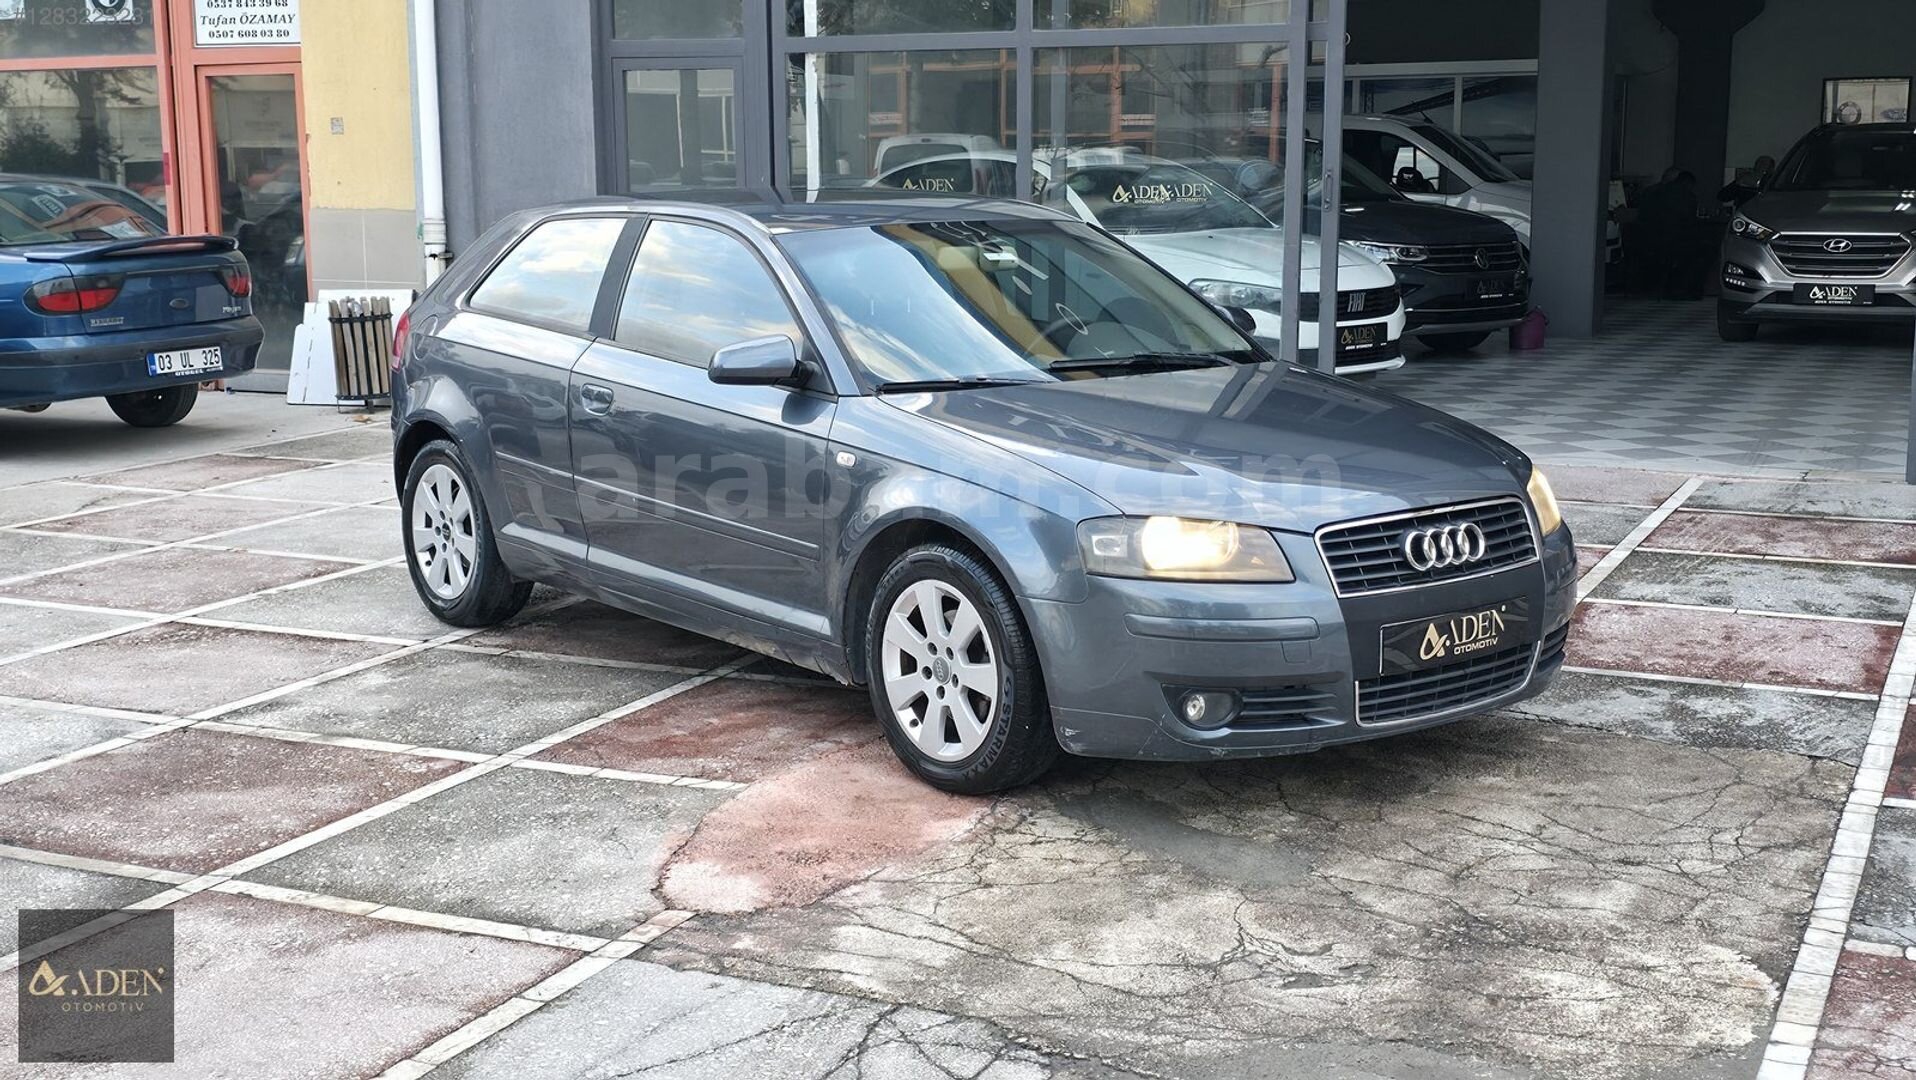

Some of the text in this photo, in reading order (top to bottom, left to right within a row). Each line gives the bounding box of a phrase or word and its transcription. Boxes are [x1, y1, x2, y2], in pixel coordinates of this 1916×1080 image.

[200, 12, 296, 28] Tufan ÖZAMAY
[208, 30, 234, 39] 0507
[260, 29, 273, 37] 03
[276, 29, 290, 37] 80
[1347, 292, 1366, 313] FIAT
[157, 348, 221, 371] 03 UL 325
[1450, 609, 1505, 646] ADEN
